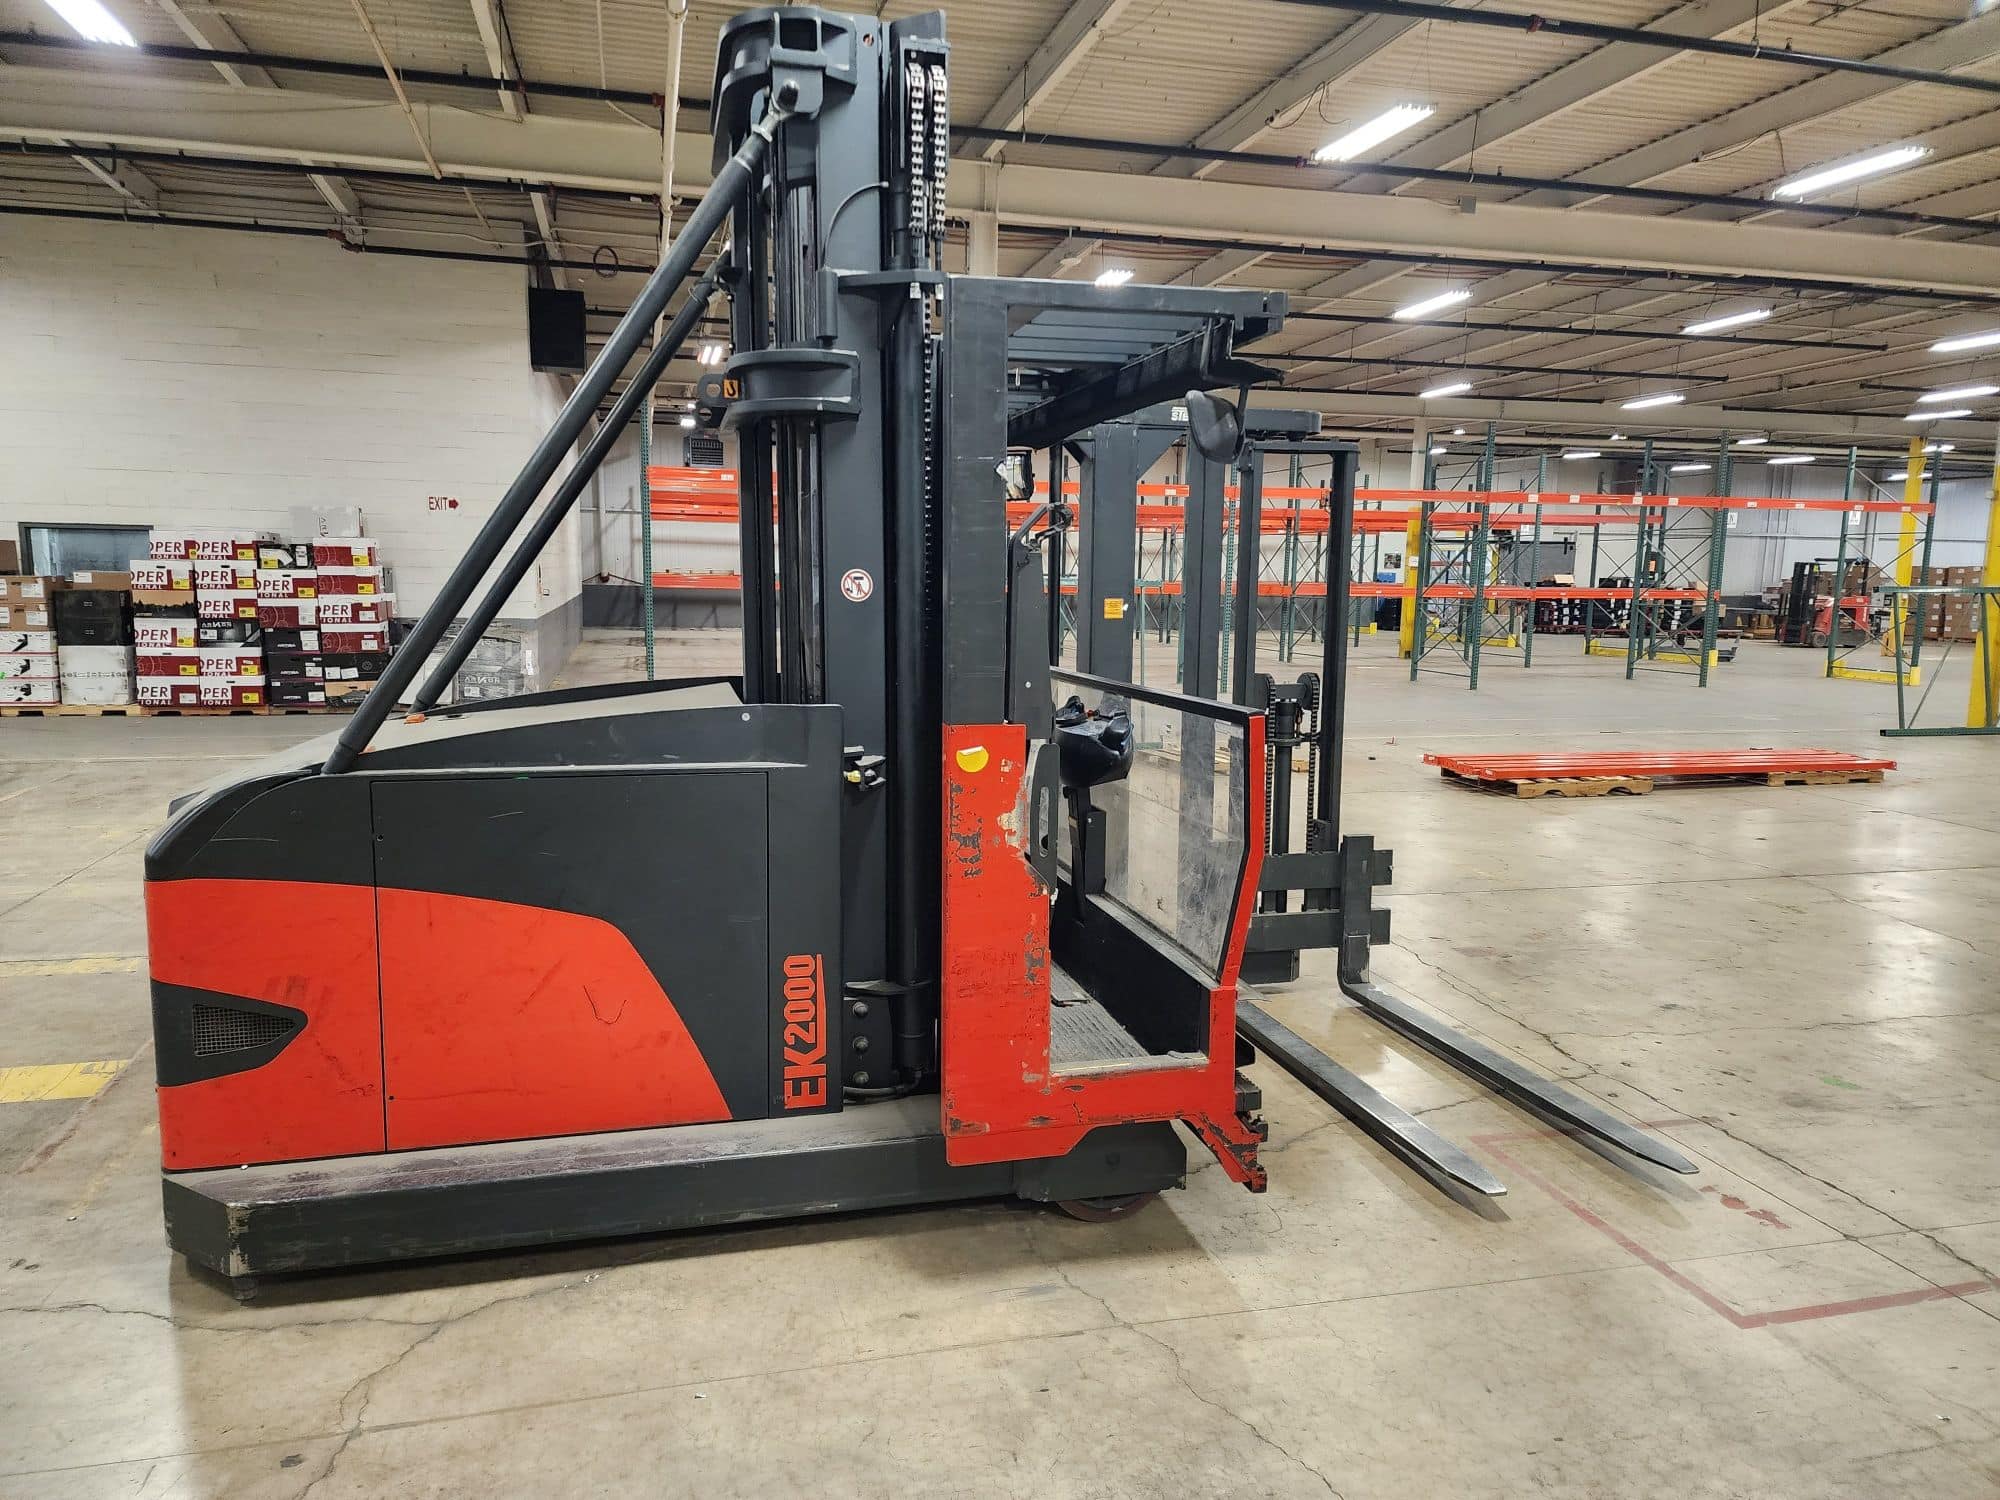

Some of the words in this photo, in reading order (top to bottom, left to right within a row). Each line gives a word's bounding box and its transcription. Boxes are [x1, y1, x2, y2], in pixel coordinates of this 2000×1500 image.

[428, 496, 448, 511] EXIT
[199, 600, 231, 611] PER
[783, 953, 827, 1110] EK2000
